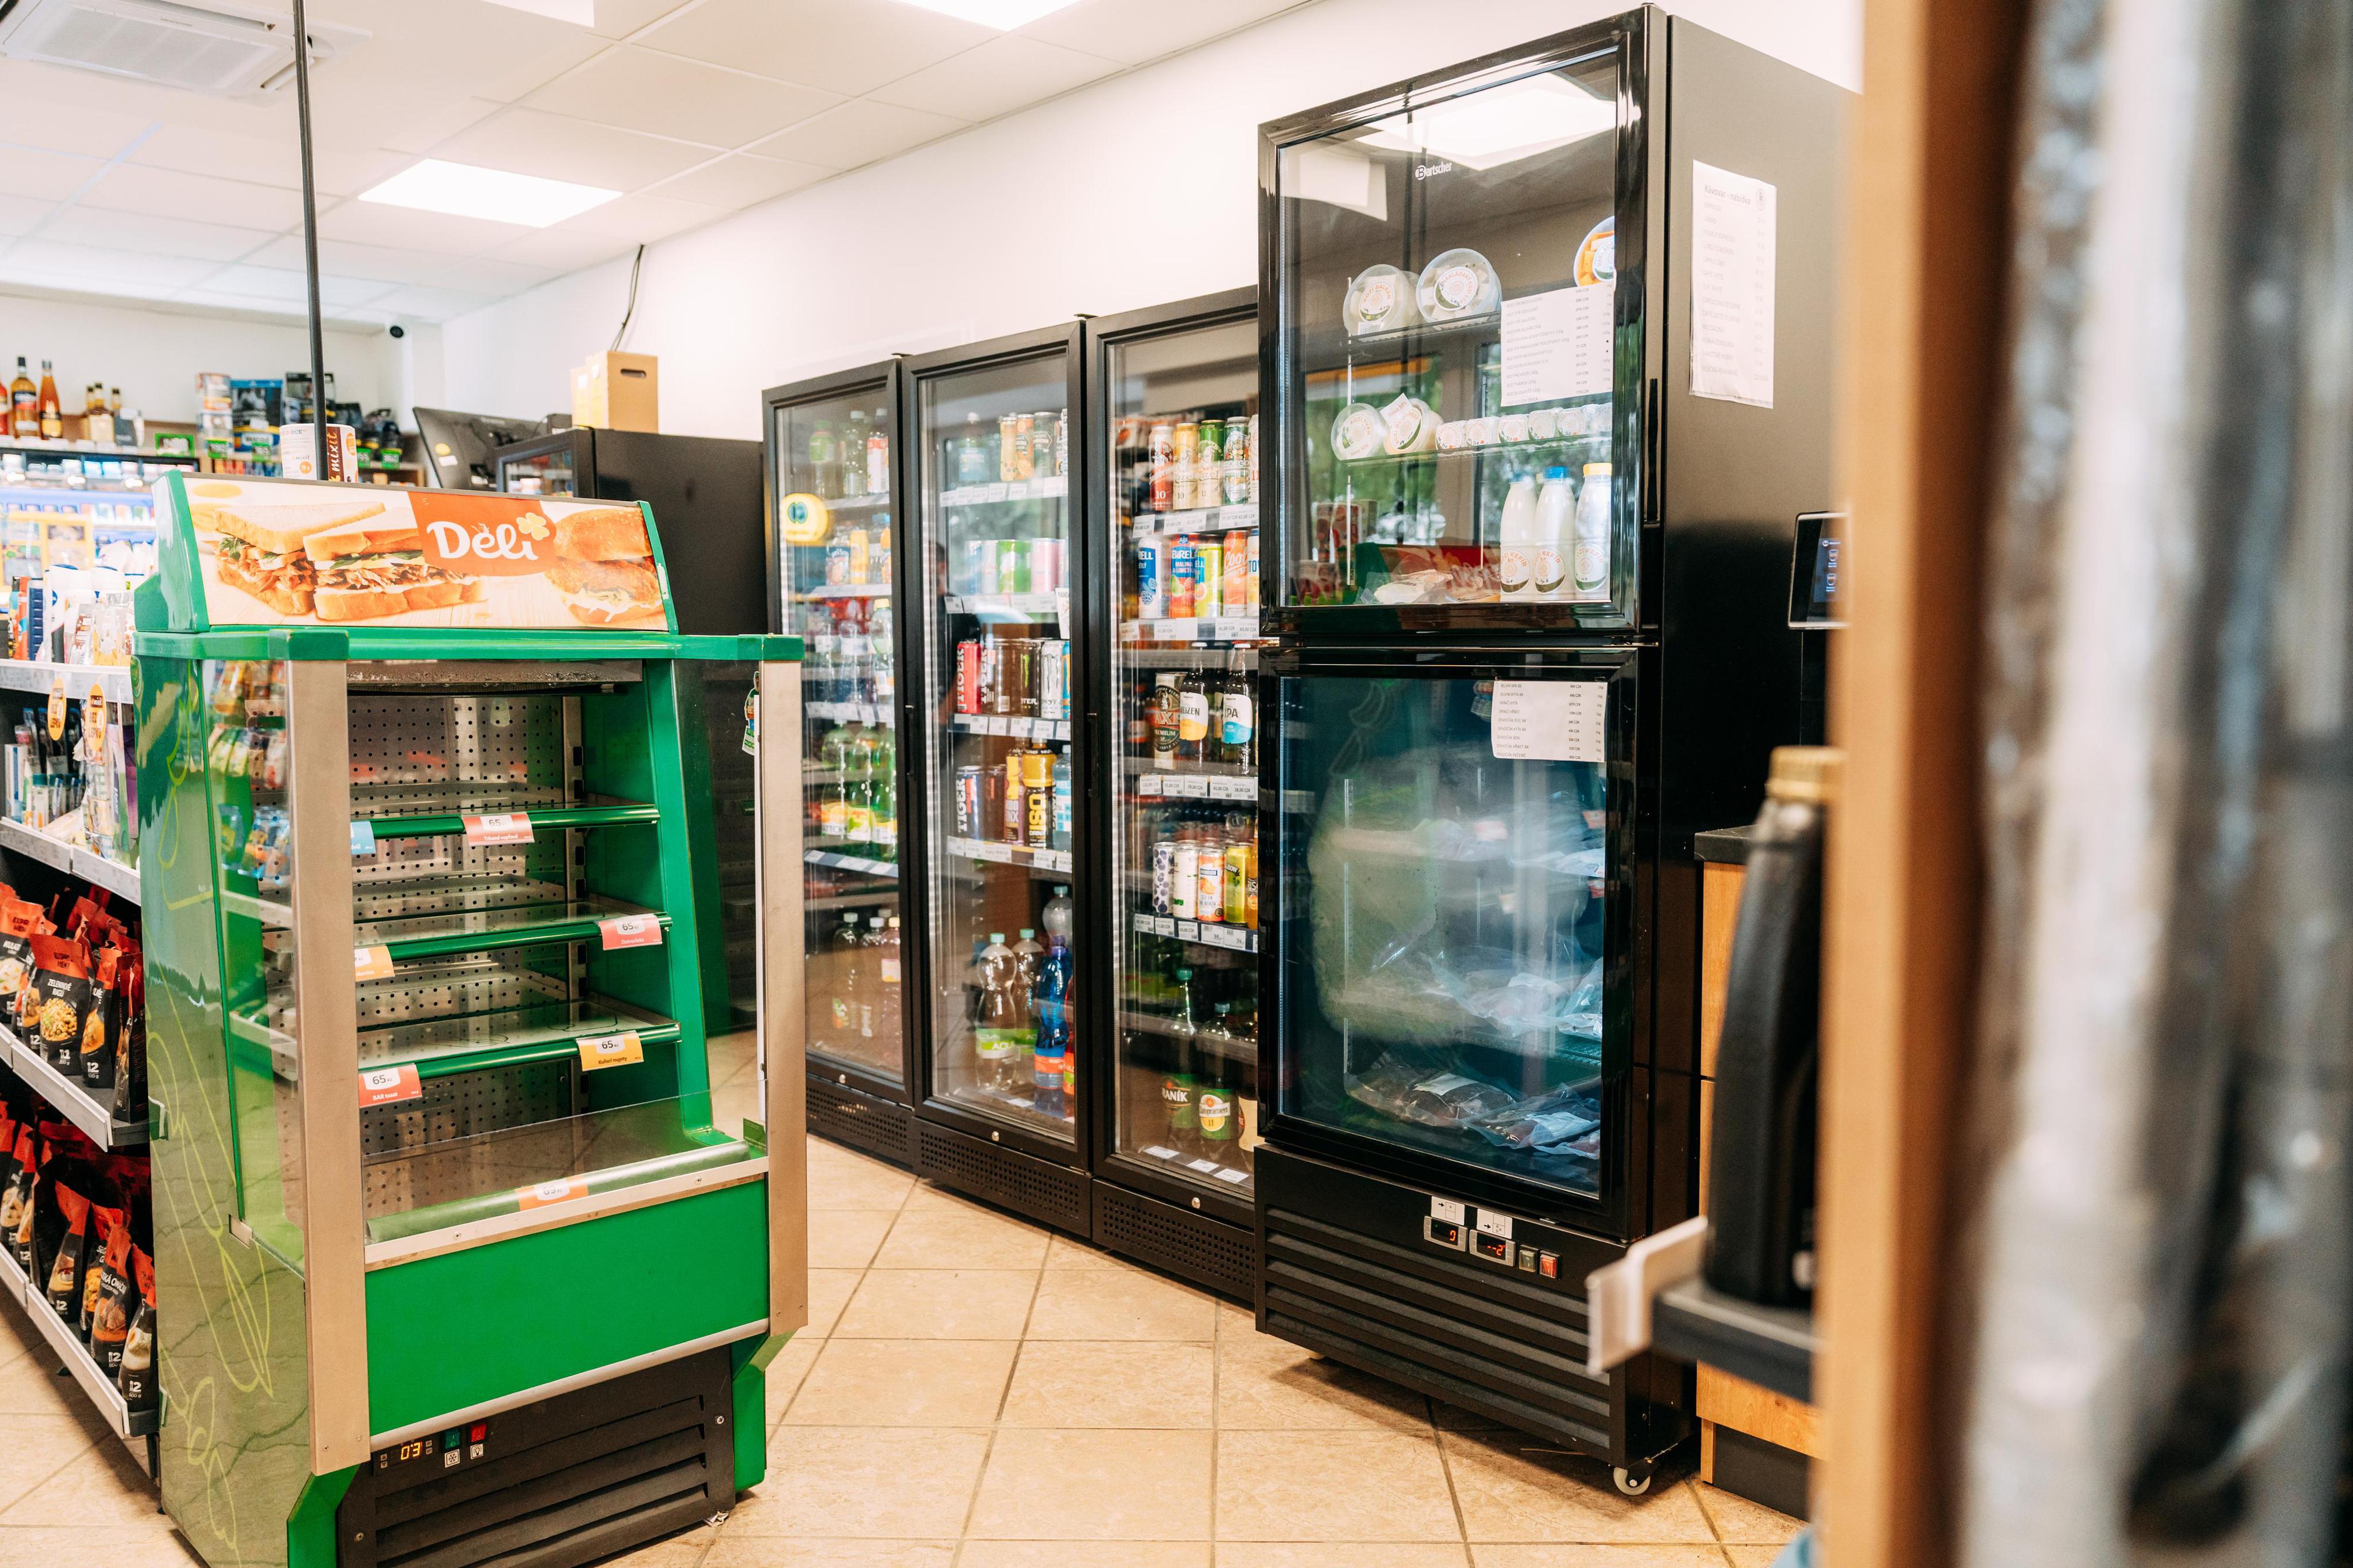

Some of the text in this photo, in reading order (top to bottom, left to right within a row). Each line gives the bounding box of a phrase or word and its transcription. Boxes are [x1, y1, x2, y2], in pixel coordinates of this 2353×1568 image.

[1415, 161, 1452, 181] Bartscher
[1155, 491, 1166, 499] 10
[1224, 708, 1238, 718] IPA
[956, 778, 967, 833] TIGER
[488, 819, 502, 827] 65
[30, 1035, 40, 1045] 12
[601, 1040, 614, 1049] 65
[87, 1062, 99, 1073] 12
[372, 1074, 386, 1085] 65
[372, 1093, 385, 1102] BAR
[1162, 1087, 1188, 1102] RANÍK
[56, 1300, 68, 1310] 12
[108, 1352, 121, 1363] 12
[129, 1380, 142, 1393] 12
